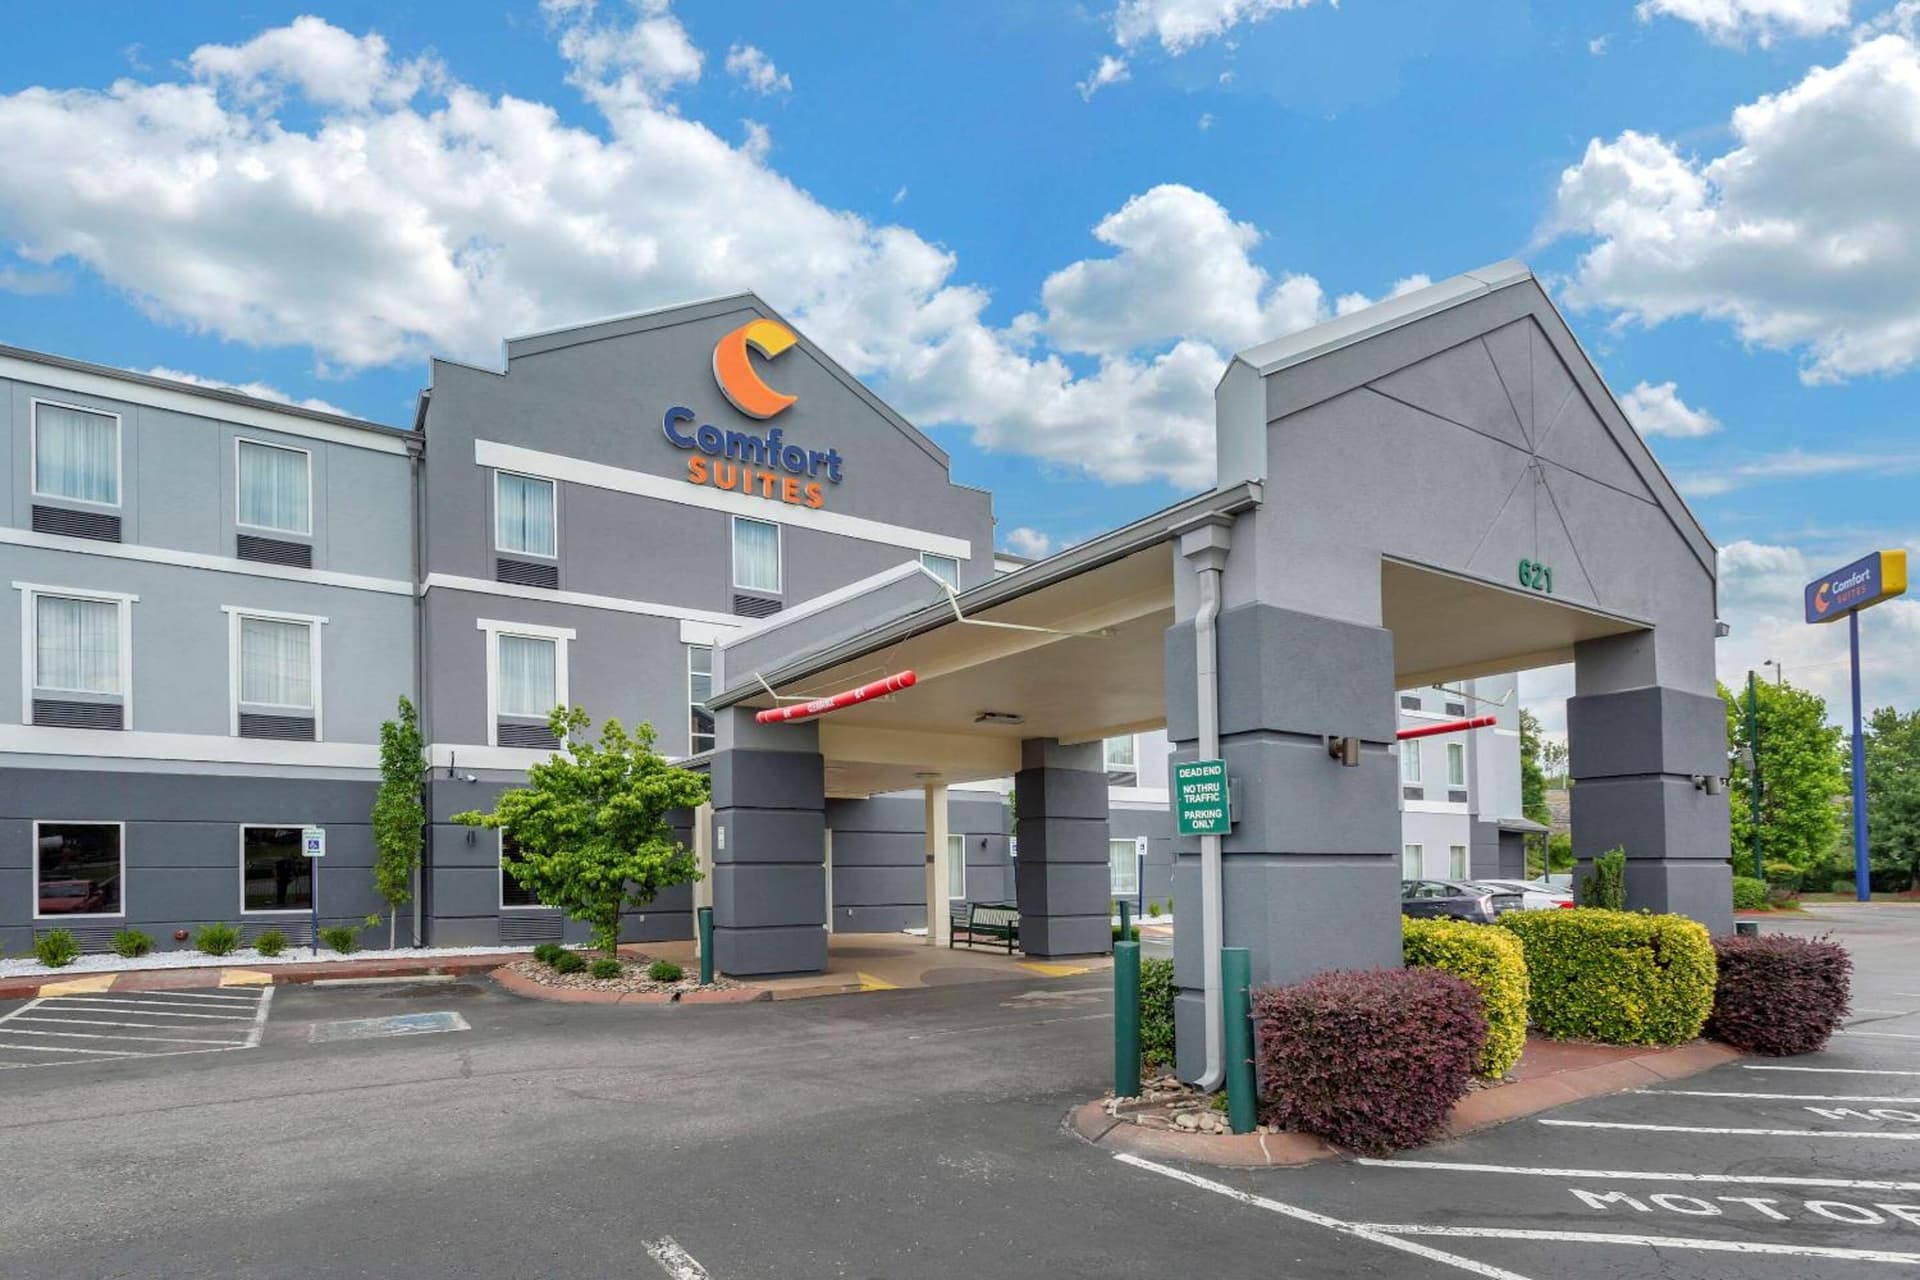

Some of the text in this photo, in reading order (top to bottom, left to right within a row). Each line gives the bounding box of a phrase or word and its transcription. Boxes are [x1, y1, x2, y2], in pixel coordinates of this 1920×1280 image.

[662, 406, 843, 484] Comfort
[687, 455, 825, 509] SUITES
[1519, 559, 1552, 593] 621
[1832, 569, 1871, 594] Comfort
[1179, 766, 1222, 778] DEAD END
[1183, 782, 1220, 794] NO THRU
[1184, 793, 1220, 804] TRAFFIC
[1184, 808, 1222, 820] PARKING
[1192, 819, 1215, 829] ONLY
